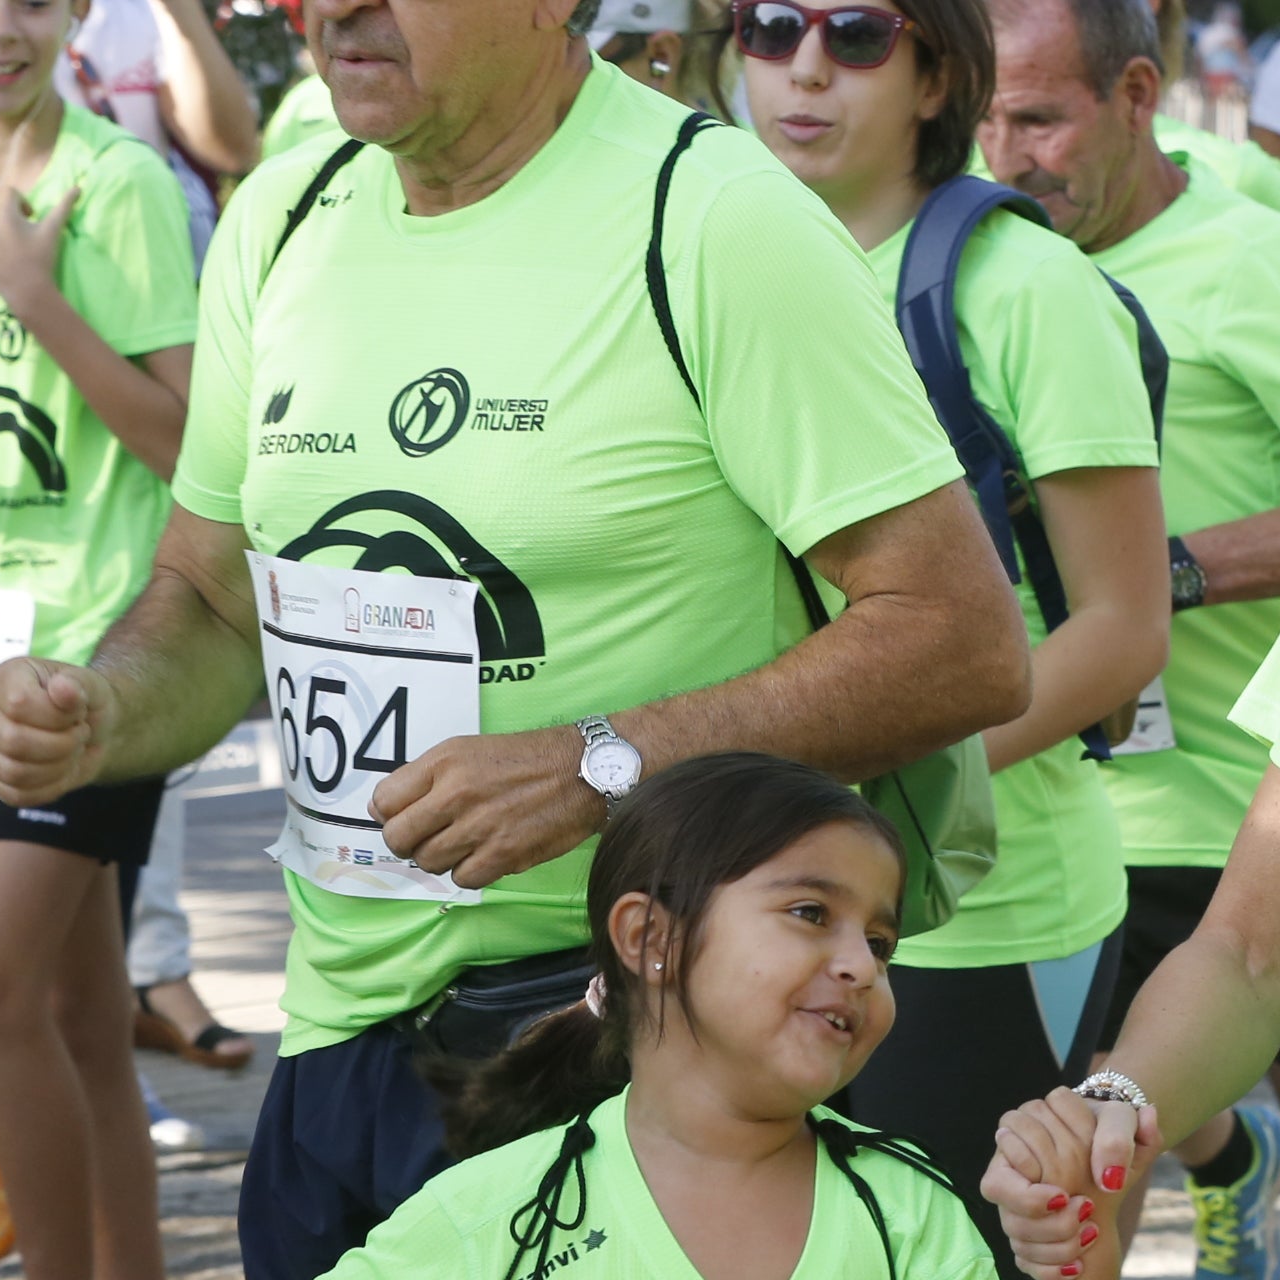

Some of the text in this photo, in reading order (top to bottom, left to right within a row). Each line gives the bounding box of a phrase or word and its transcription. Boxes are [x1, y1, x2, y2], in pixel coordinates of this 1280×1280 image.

[476, 398, 548, 412] UNIVERSO
[471, 413, 545, 432] MUJER
[258, 433, 357, 455] IBERDROLA
[363, 603, 435, 631] GRANADA
[277, 666, 410, 794] 654
